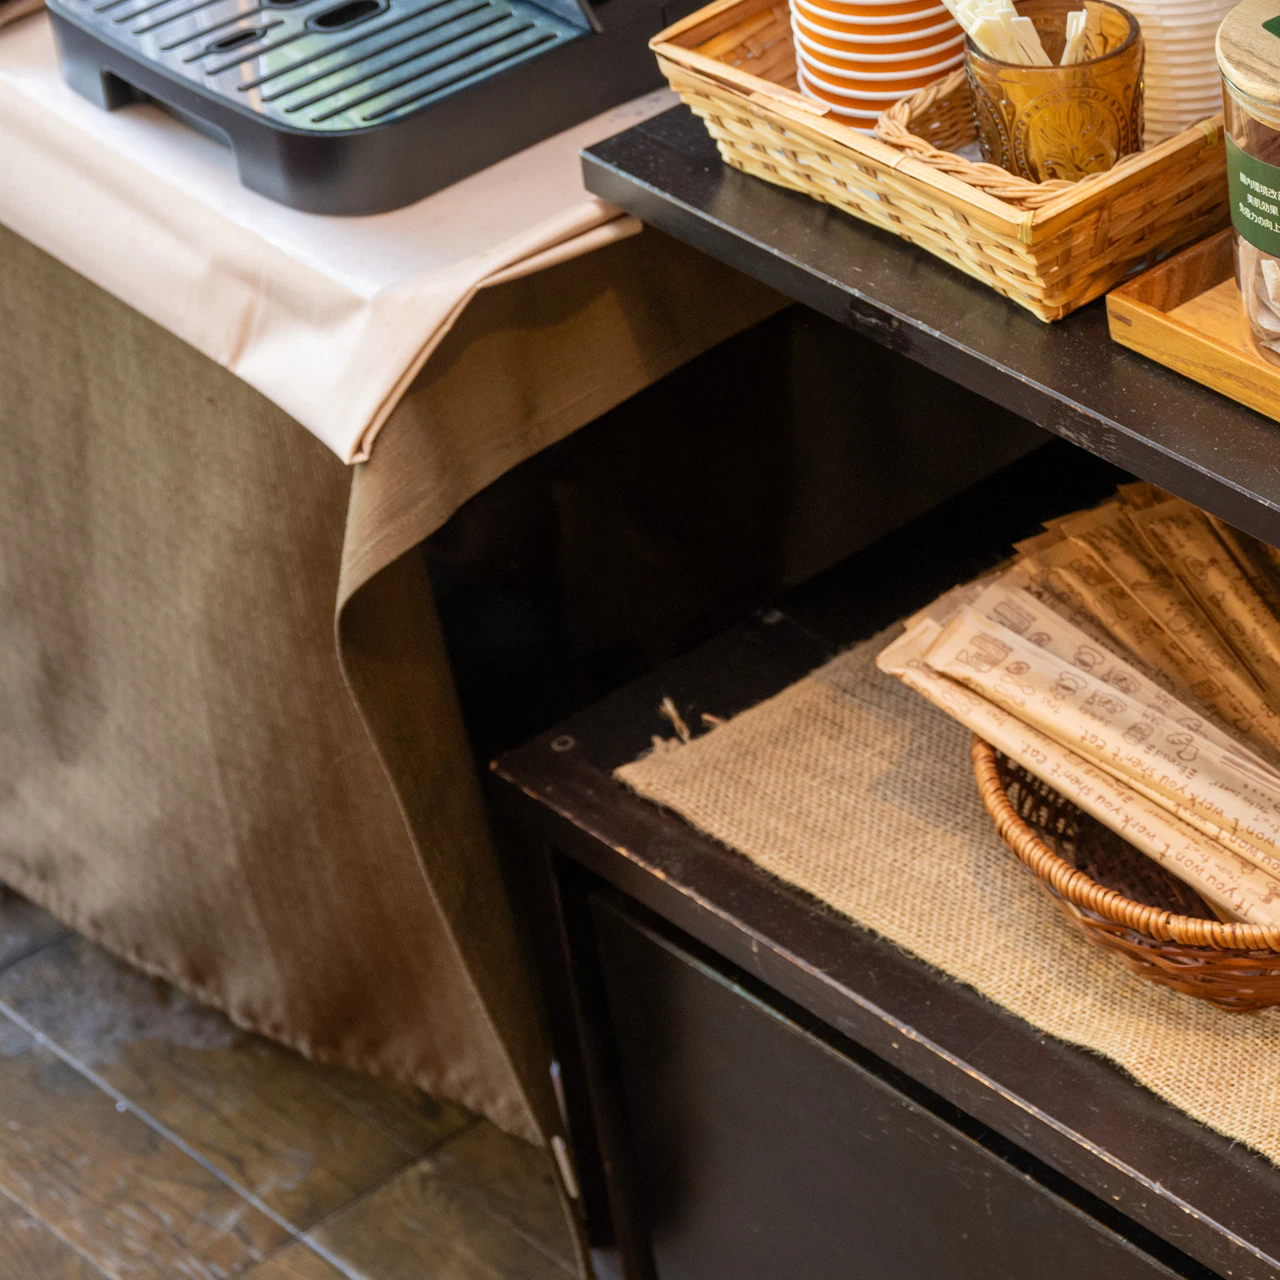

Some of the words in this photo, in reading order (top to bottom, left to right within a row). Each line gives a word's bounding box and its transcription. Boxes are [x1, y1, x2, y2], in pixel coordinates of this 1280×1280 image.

[1247, 193, 1279, 216] 美肌効果
[1188, 788, 1226, 818] work
[1120, 814, 1158, 842] work
[1230, 817, 1276, 850] won't
[1158, 842, 1206, 877] won't
[1206, 874, 1240, 895] you
[1234, 901, 1256, 918] If
